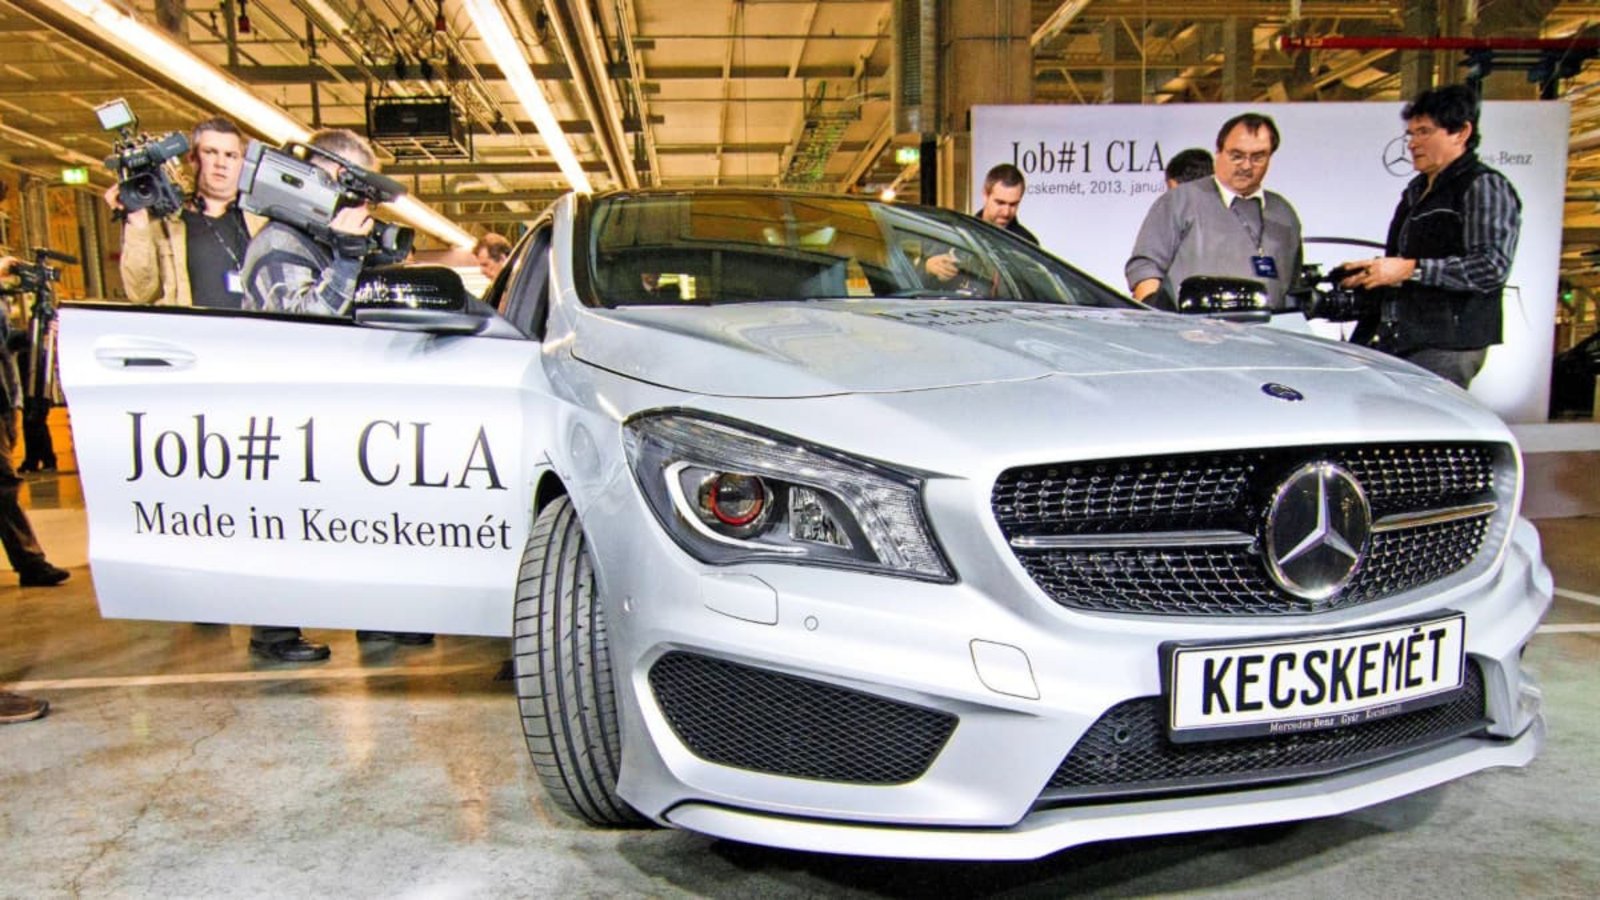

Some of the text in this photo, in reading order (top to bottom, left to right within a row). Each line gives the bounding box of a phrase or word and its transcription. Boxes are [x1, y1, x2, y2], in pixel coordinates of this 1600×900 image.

[1011, 140, 1166, 174] Job#1 CLA
[1027, 179, 1086, 196] cskemét,
[1089, 180, 1126, 195] 2013.
[126, 411, 508, 491] Job#1 CLA
[132, 500, 512, 551] Made in Kecskemét
[1202, 627, 1446, 715] KECSKEMÉT
